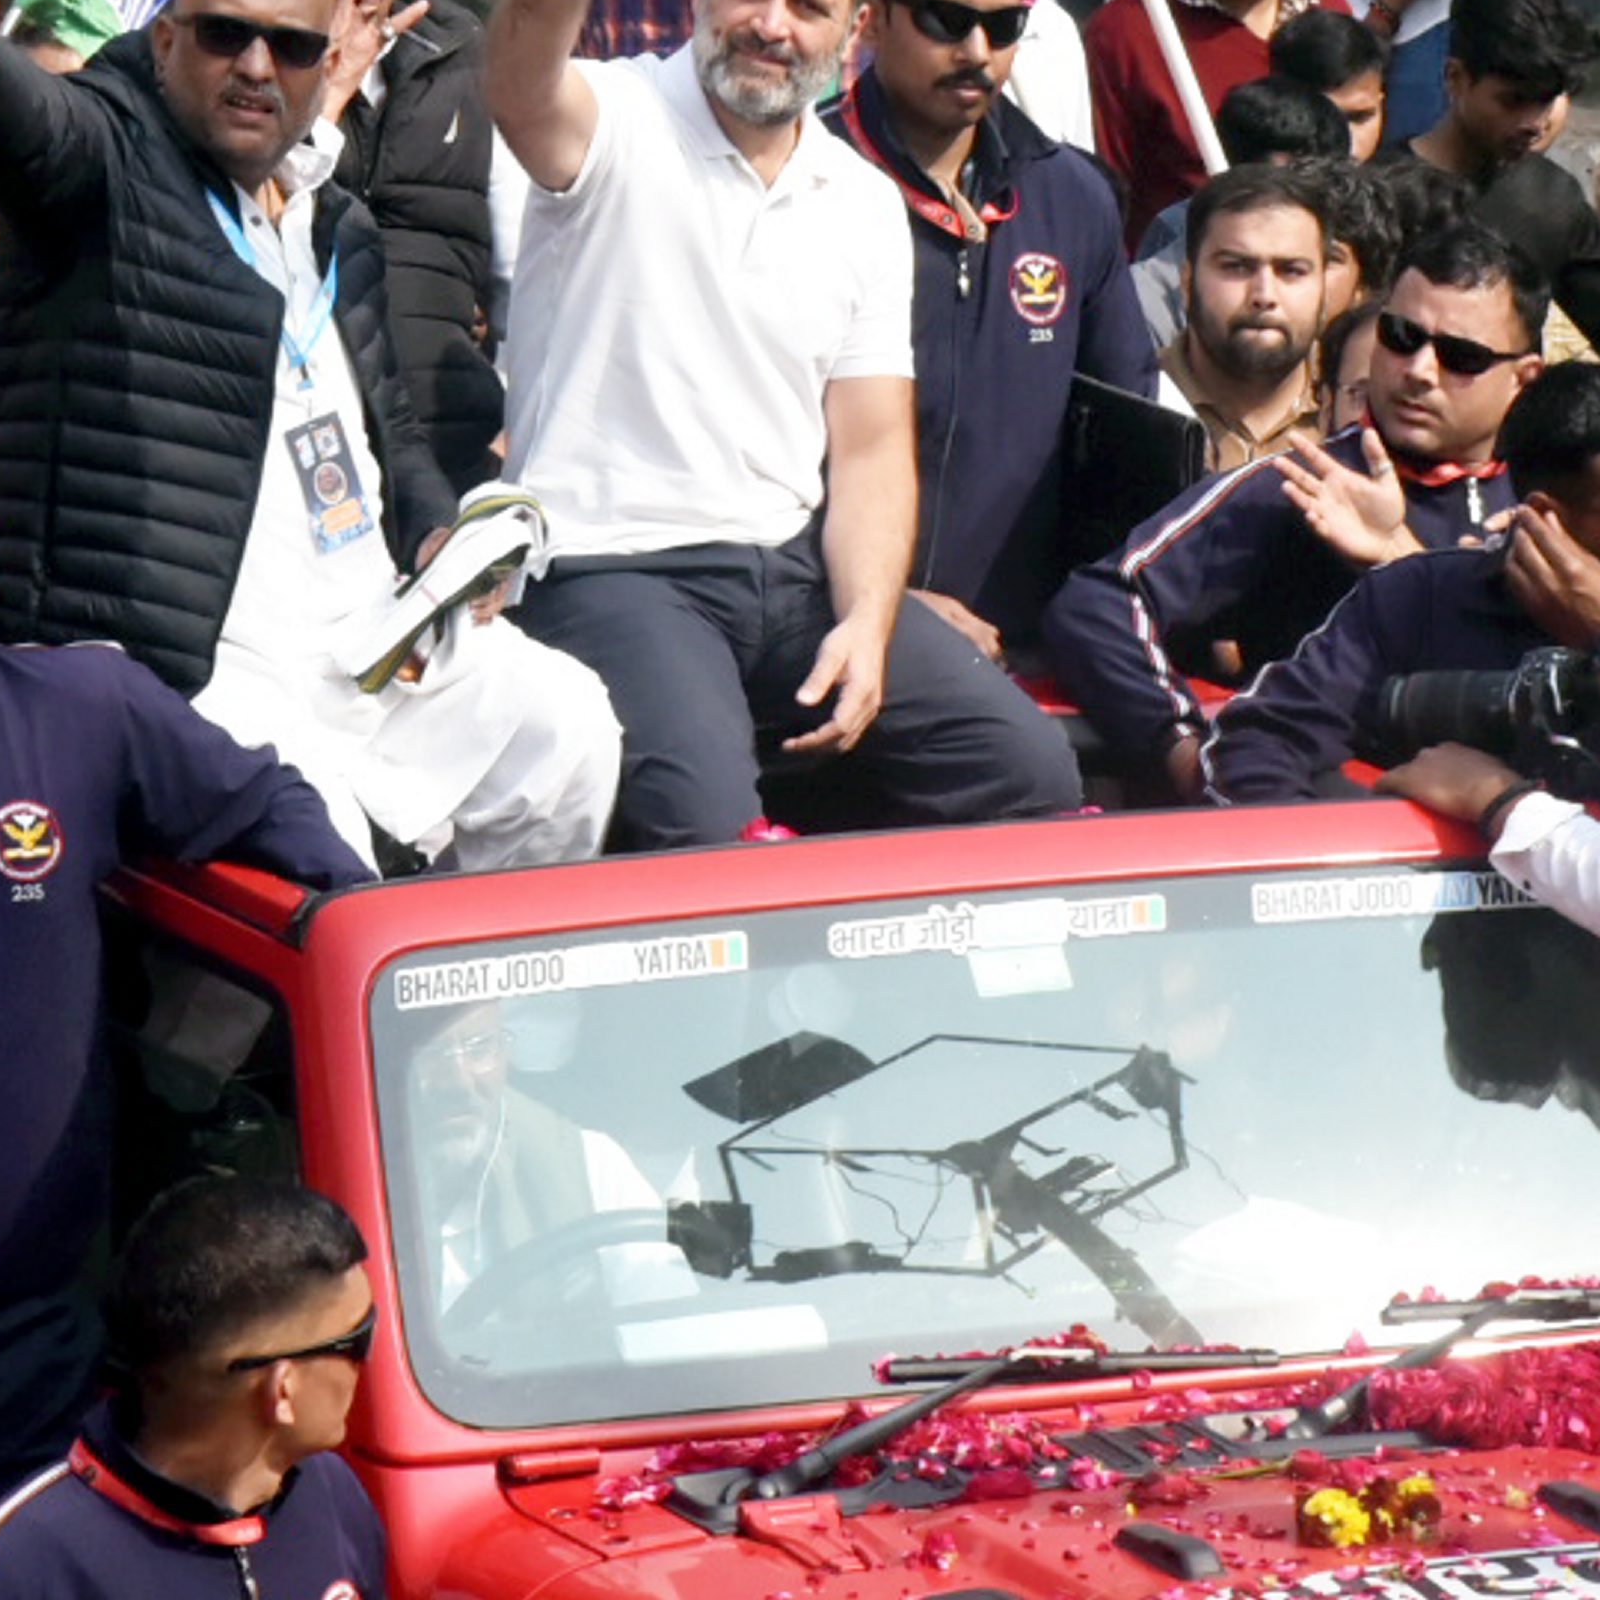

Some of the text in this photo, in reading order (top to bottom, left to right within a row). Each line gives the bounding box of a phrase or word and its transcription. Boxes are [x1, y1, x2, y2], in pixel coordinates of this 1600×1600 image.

[1256, 885, 1343, 917] BHARAT
[1351, 880, 1413, 909] JODO
[832, 921, 905, 953] भारत
[918, 905, 976, 951] जोड़ो
[1067, 901, 1131, 931] यात्रा
[398, 964, 490, 1005] BHARAT
[497, 954, 565, 992] JODO
[634, 940, 708, 976] YATRA
